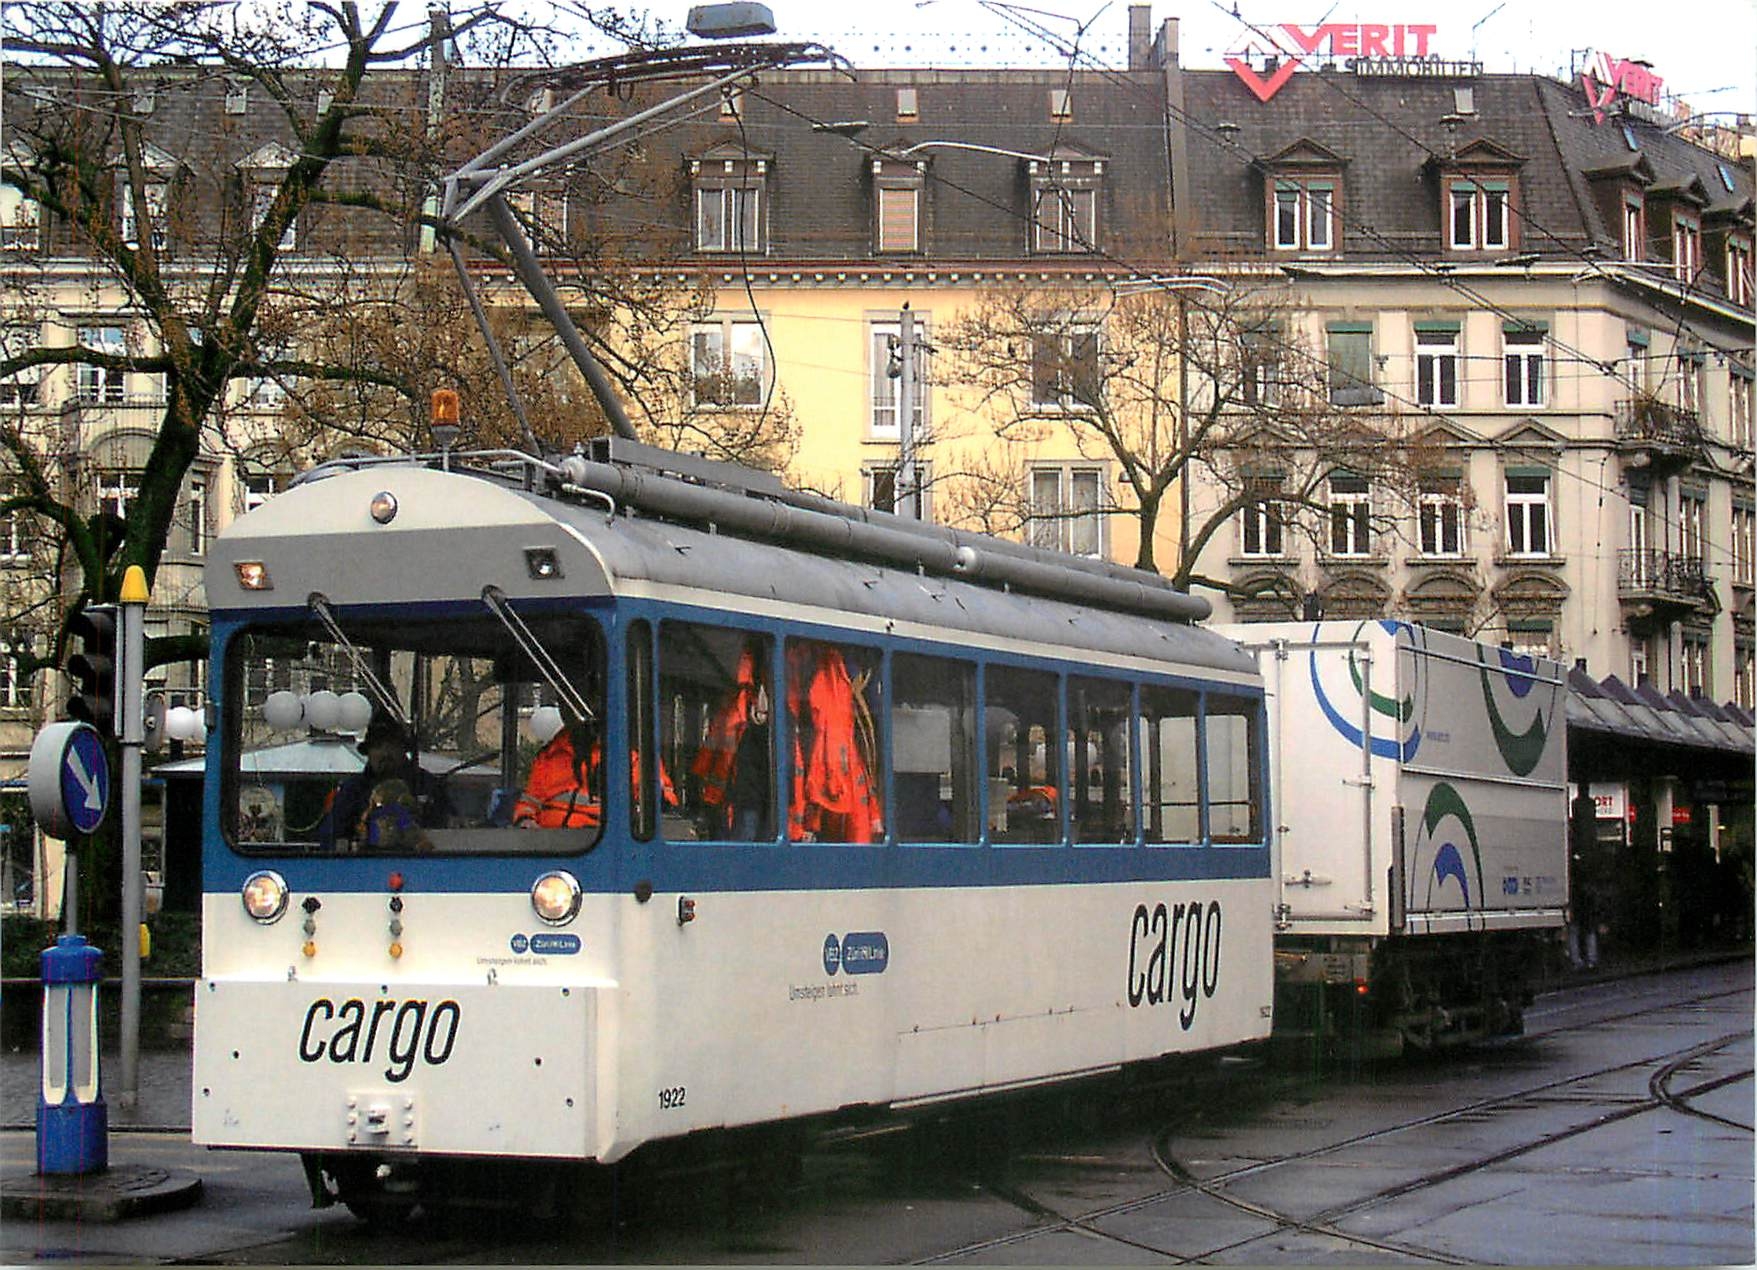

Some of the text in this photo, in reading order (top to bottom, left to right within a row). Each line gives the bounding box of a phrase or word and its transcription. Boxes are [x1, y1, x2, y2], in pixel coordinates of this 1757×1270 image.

[1279, 23, 1438, 57] VERIT
[1357, 61, 1484, 77] IMMOBILIEN
[1128, 900, 1222, 1031] cargo
[299, 997, 461, 1083] cargo
[658, 1086, 686, 1109] 1922
